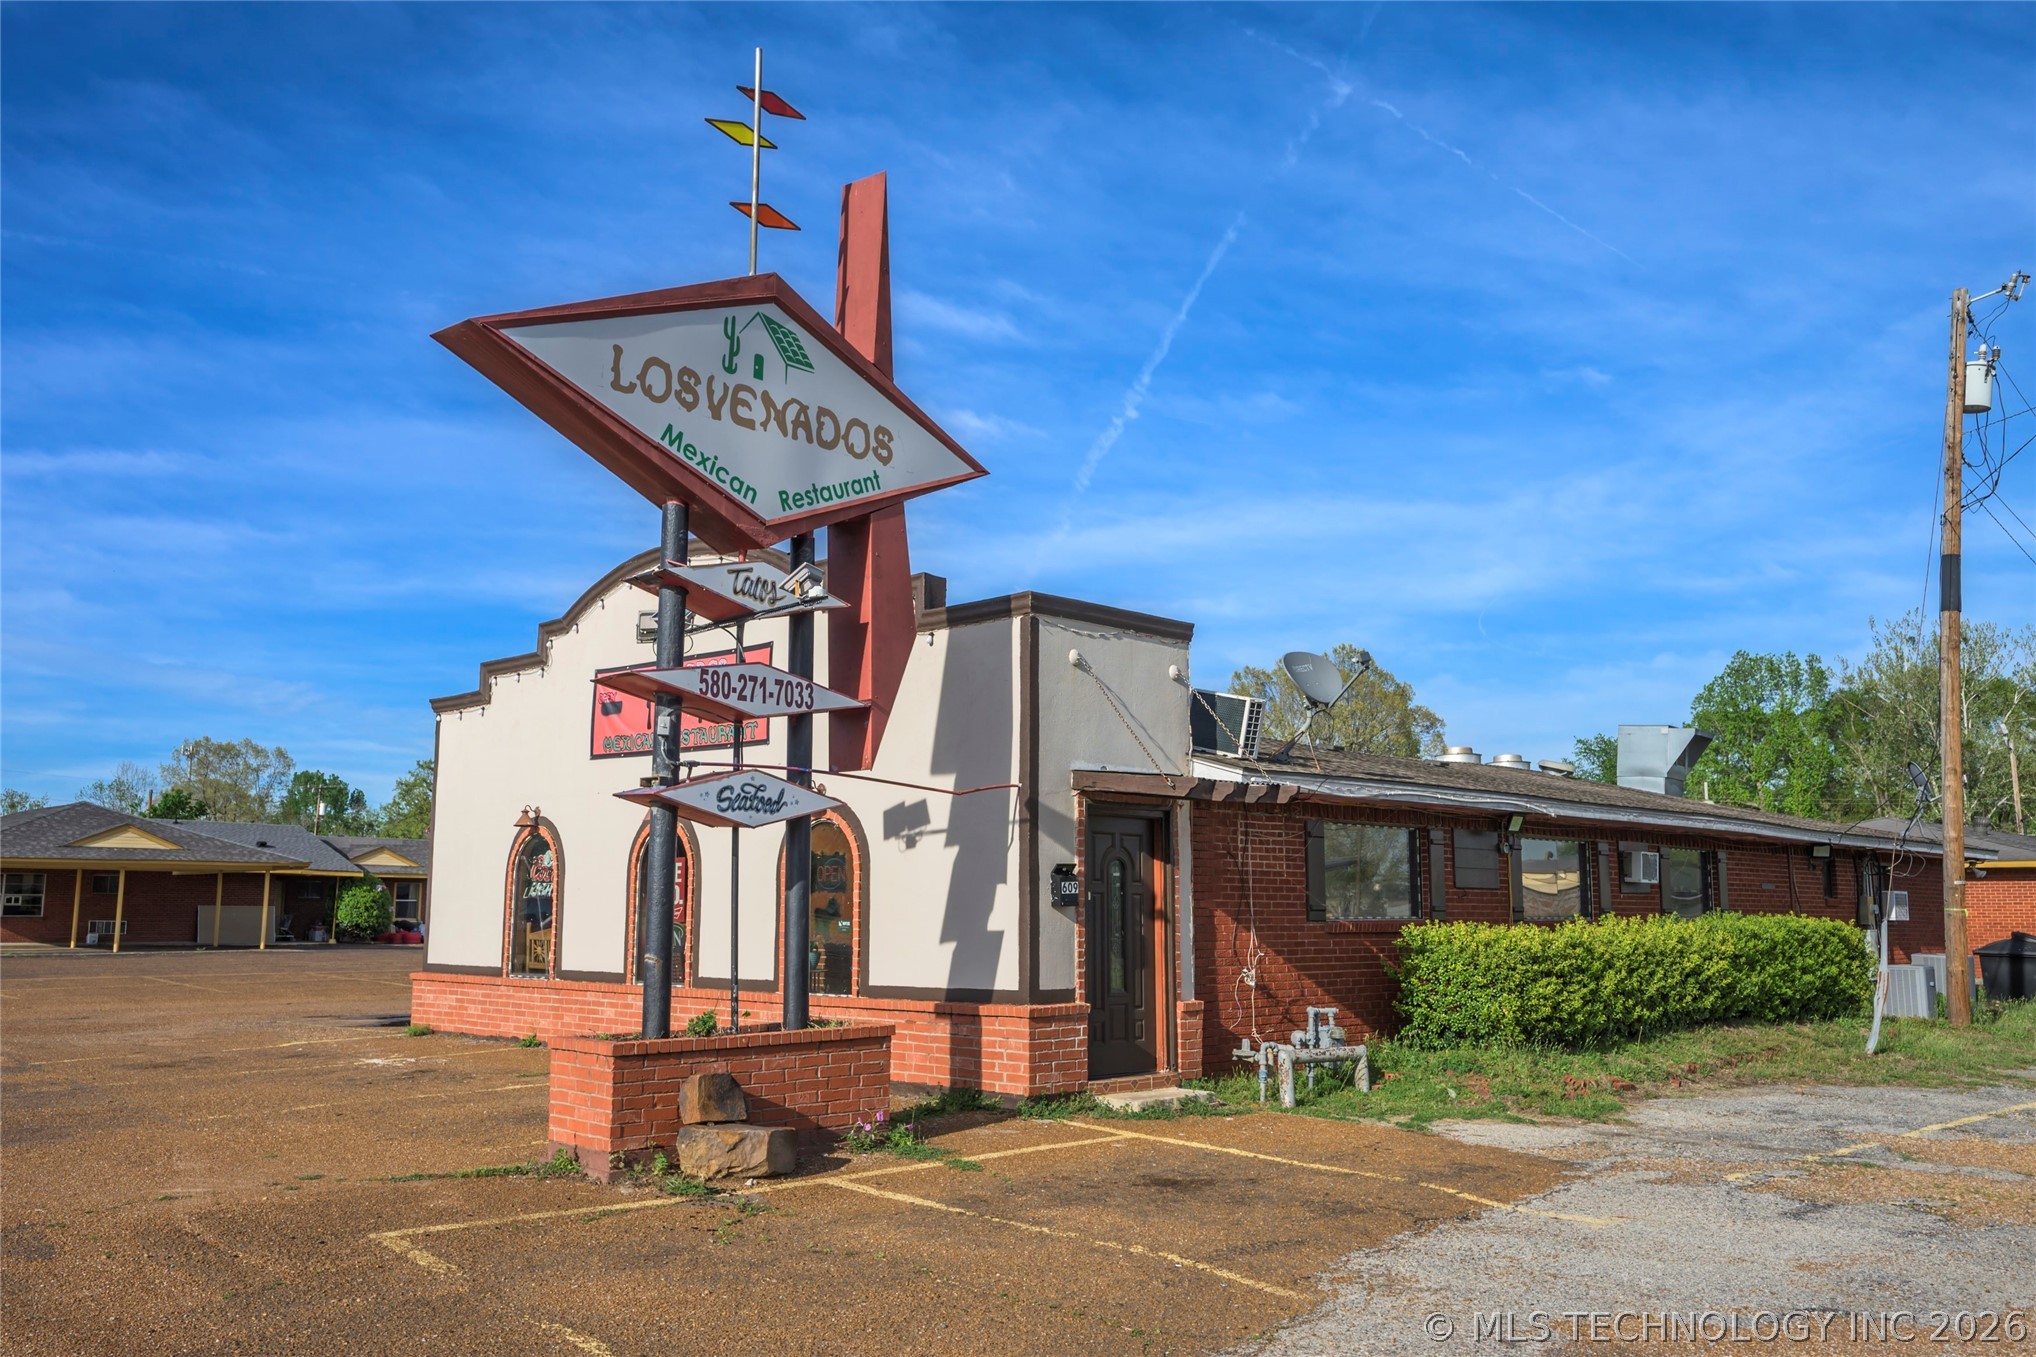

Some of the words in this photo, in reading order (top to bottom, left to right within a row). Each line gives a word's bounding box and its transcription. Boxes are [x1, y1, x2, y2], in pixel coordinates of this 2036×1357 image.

[659, 422, 758, 505] Mexican
[778, 469, 882, 512] Restaurant
[726, 567, 788, 606] Tacos
[698, 667, 815, 710] 580-271-7033
[603, 732, 655, 752] MEXICA
[681, 721, 758, 746] STAURAT
[716, 782, 788, 815] Seafood
[816, 865, 847, 882] OPEN
[1062, 882, 1078, 893] 609
